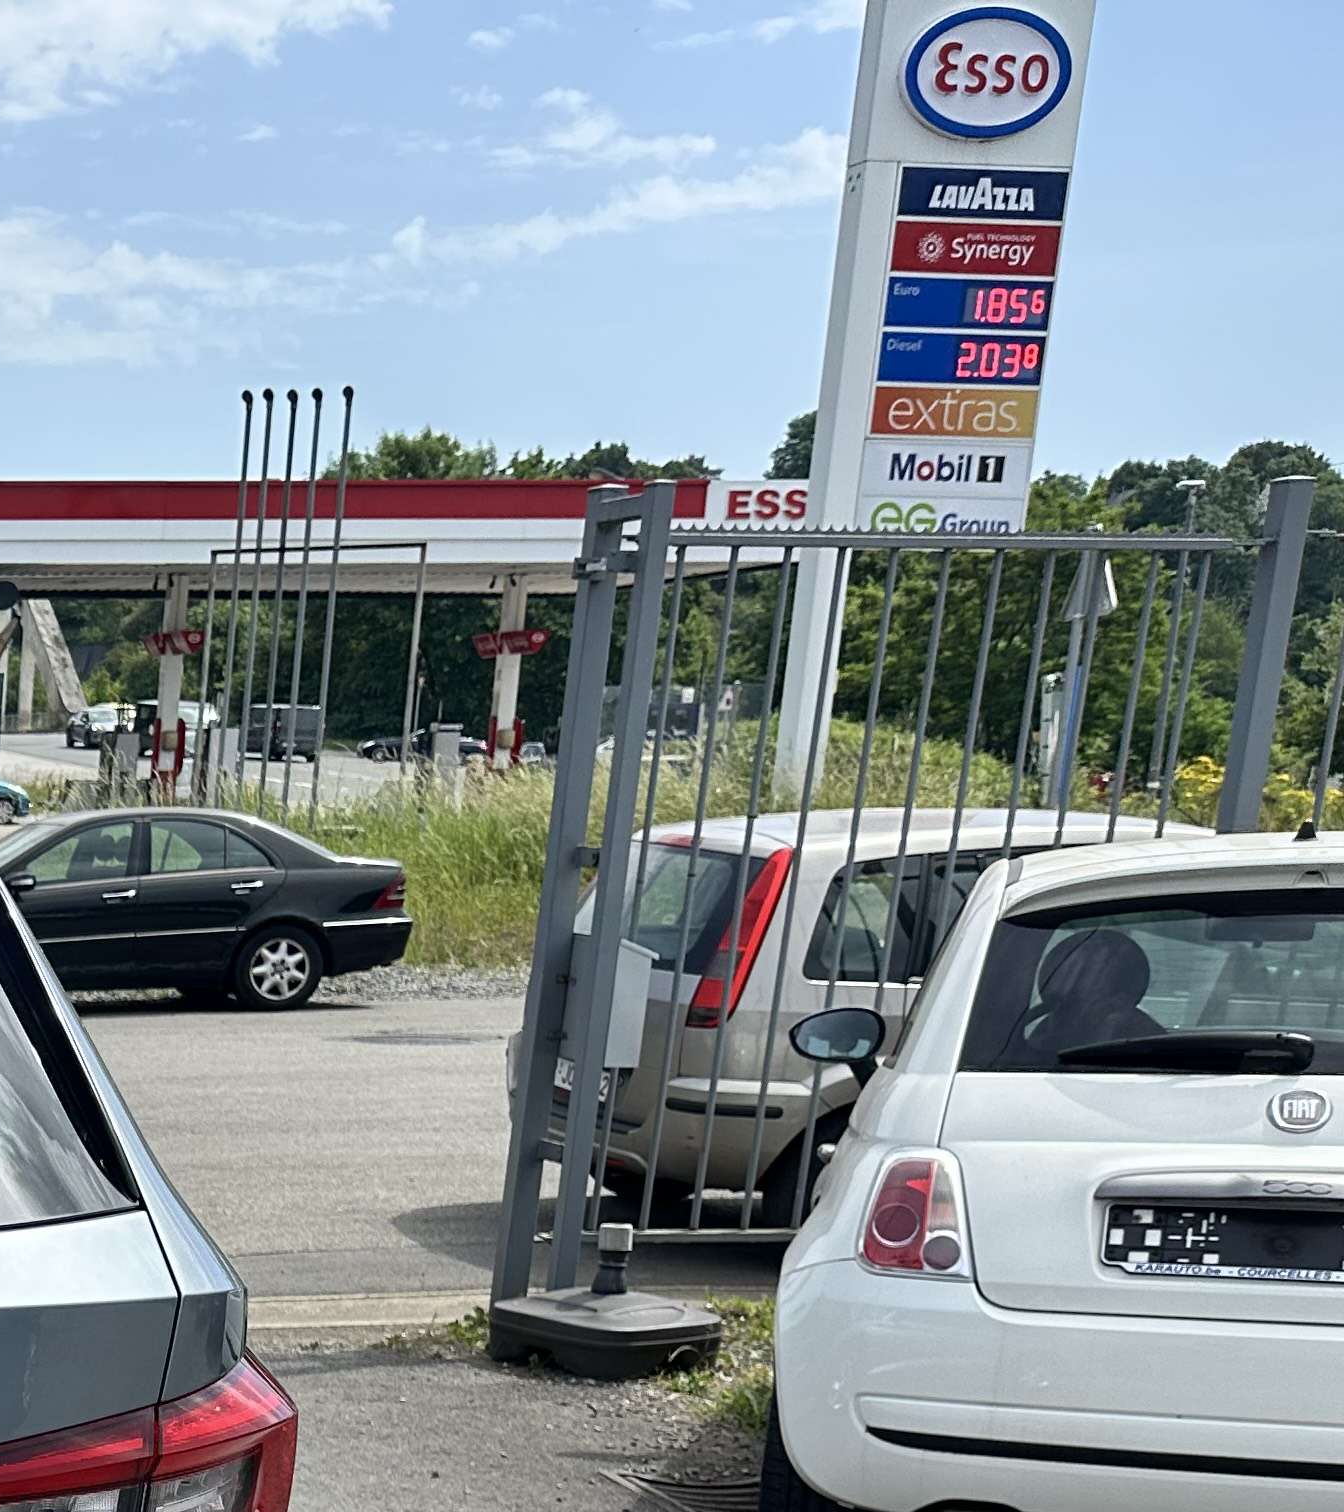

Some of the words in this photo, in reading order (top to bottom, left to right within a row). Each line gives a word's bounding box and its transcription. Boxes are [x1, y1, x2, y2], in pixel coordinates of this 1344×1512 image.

[928, 177, 1035, 212] LAVAZZA
[950, 237, 1035, 266] Synergy
[892, 282, 920, 297] Euro
[885, 338, 924, 352] Diesel
[888, 389, 1020, 433] extras
[888, 453, 973, 482] Mobil
[726, 489, 809, 520] ESS
[1282, 1098, 1320, 1119] FIAT
[1262, 1179, 1333, 1195] 500
[1134, 1262, 1222, 1276] KARAUTObe
[1236, 1267, 1332, 1281] COURCELLES
